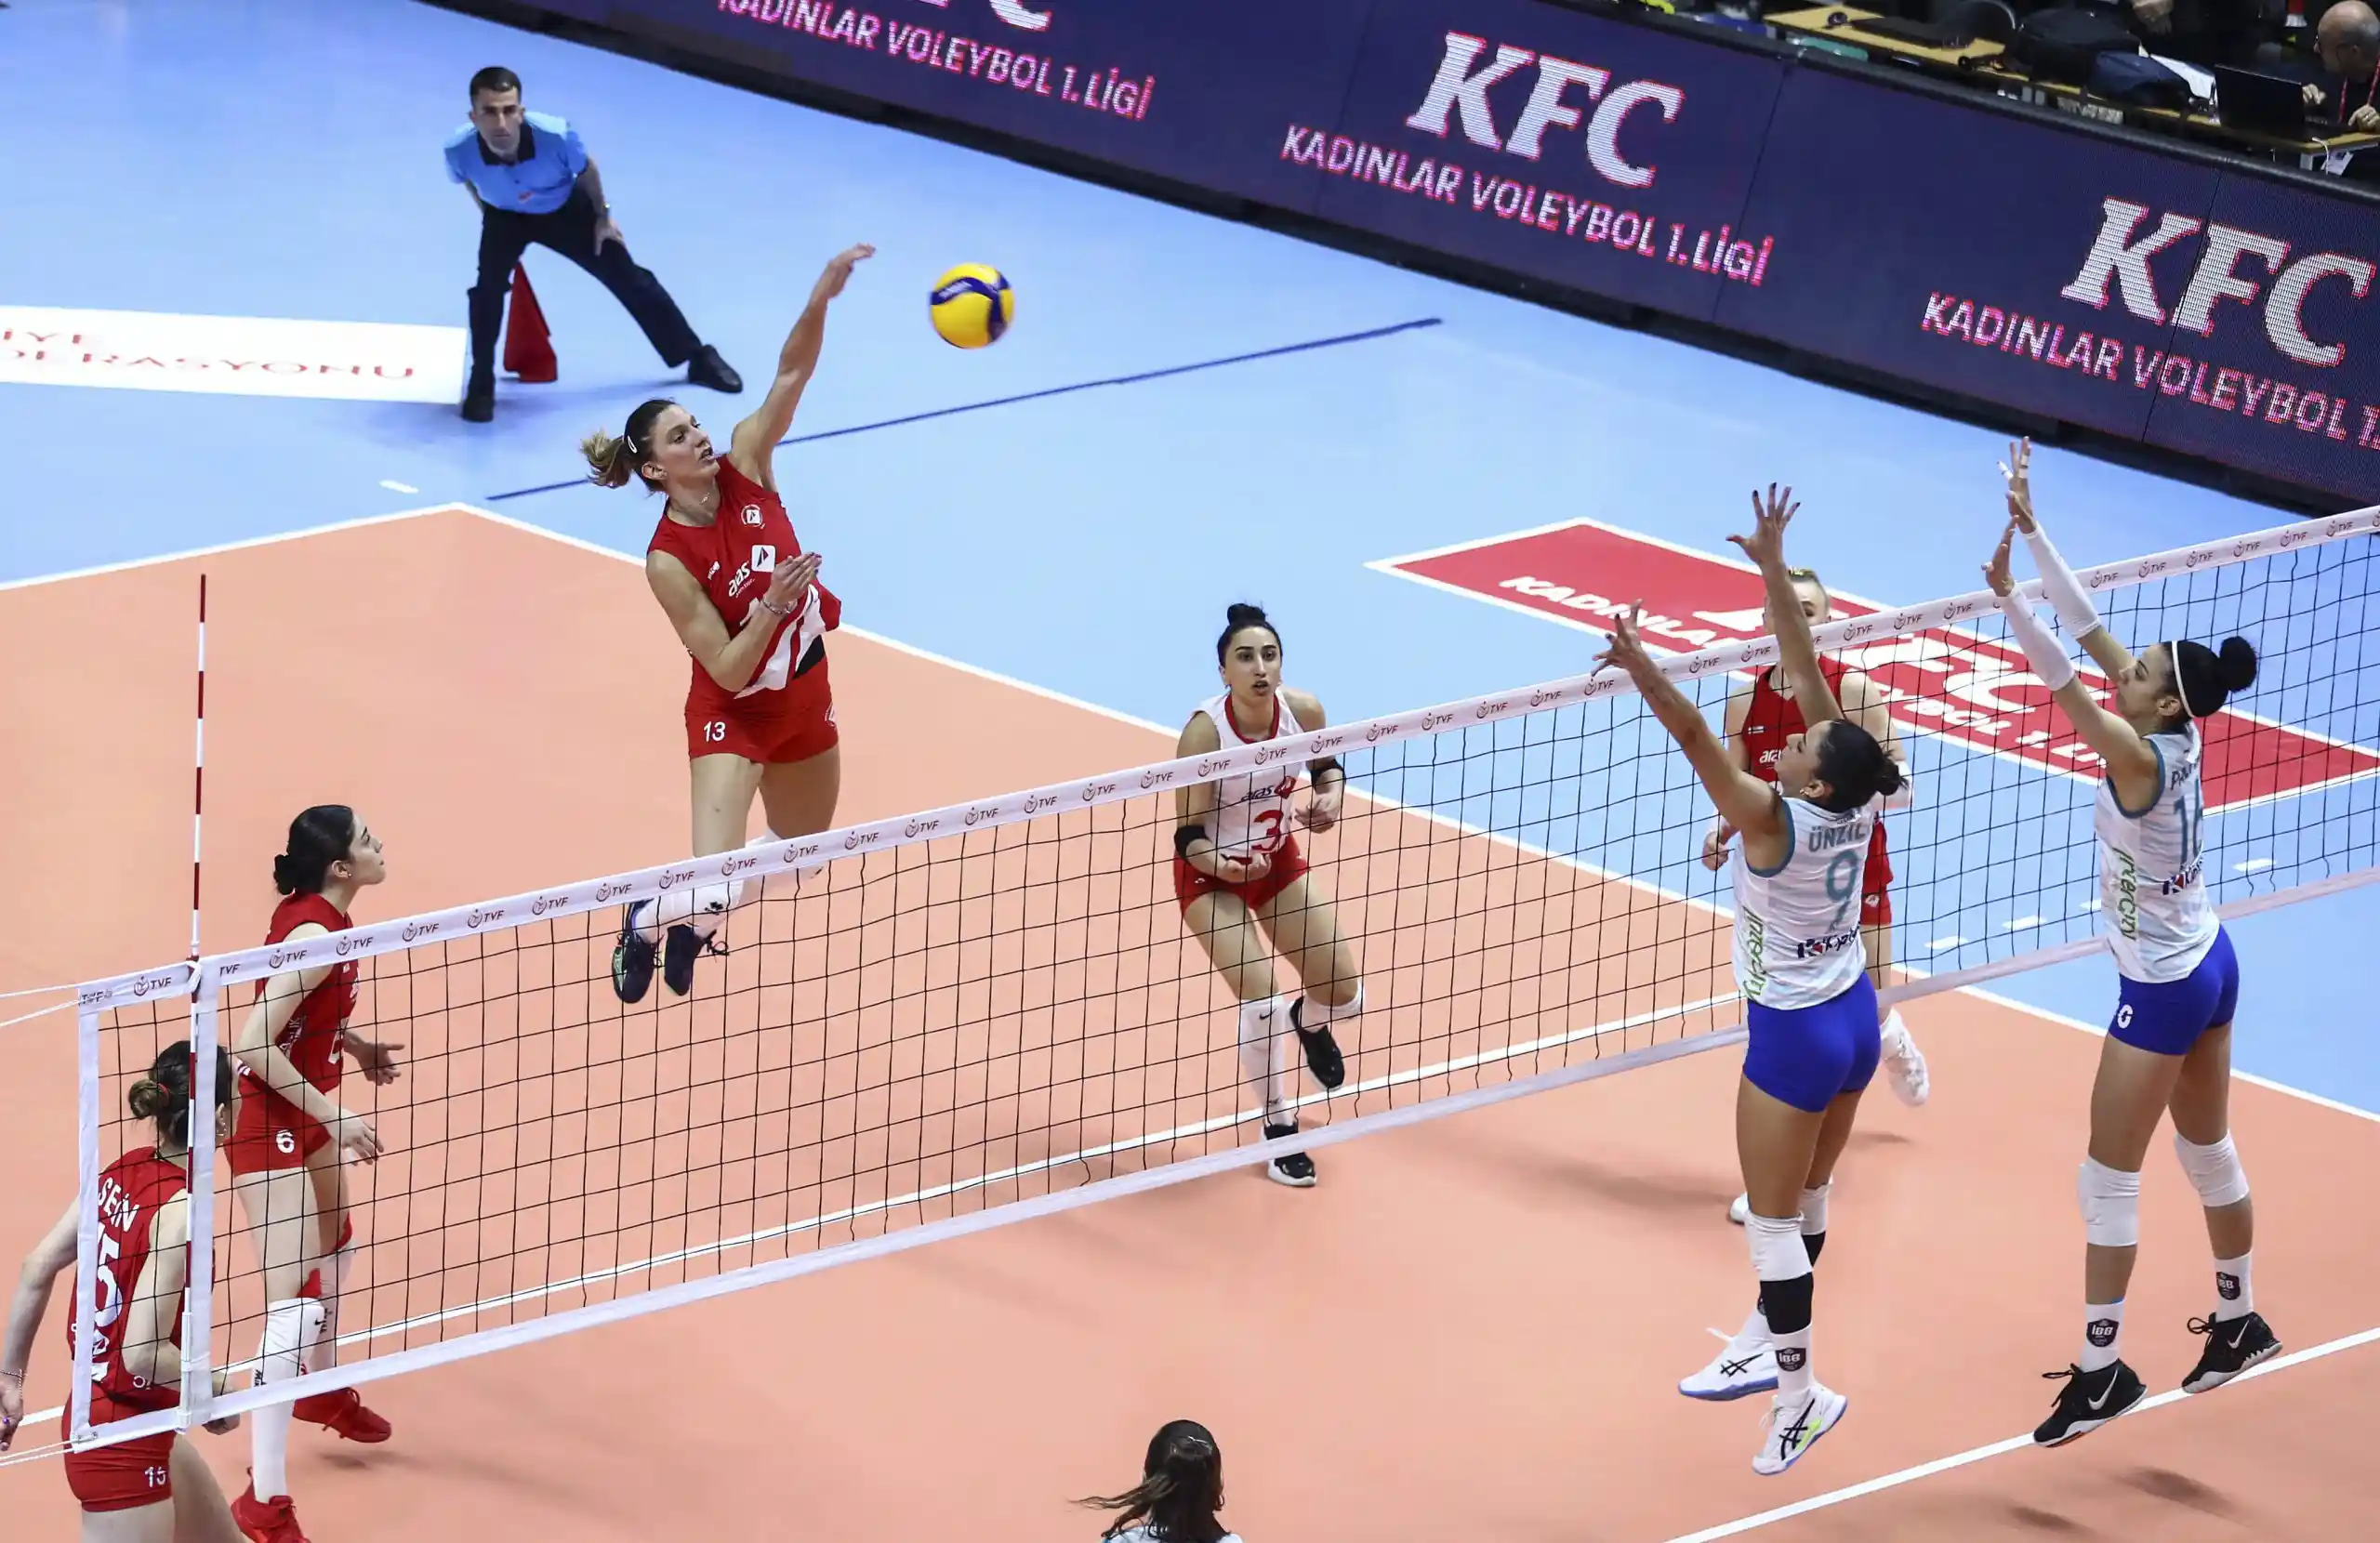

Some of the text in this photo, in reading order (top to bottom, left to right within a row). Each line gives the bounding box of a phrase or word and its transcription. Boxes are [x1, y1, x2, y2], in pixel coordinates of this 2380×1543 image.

[887, 20, 1053, 97] VOLEYBOL
[1404, 30, 1686, 189] KFC
[1280, 123, 1463, 205] KADINLAR
[1472, 170, 1657, 257] VOLEYBOL
[2060, 195, 2377, 366] KFC
[1921, 291, 2124, 381] KADINLAR
[2134, 345, 2347, 442] VOLEYBOL
[1956, 602, 1974, 615] TVF
[1906, 613, 1924, 626] TVF
[1856, 624, 1874, 637] TVF
[1753, 645, 1771, 658] TVF
[1702, 656, 1721, 669] TVF
[1597, 679, 1615, 692] TVF
[1543, 691, 1563, 703] TVF
[1489, 702, 1509, 715] TVF
[1435, 713, 1454, 726] TVF
[704, 720, 726, 742] 13
[1380, 724, 1399, 737] TVF
[1325, 735, 1343, 748] TVF
[1269, 747, 1288, 760] TVF
[1211, 758, 1232, 772] TVF
[1155, 771, 1174, 784] TVF
[1097, 784, 1117, 797] TVF
[1038, 796, 1058, 809] TVF
[979, 808, 999, 821] TVF
[919, 820, 940, 833] TVF
[1250, 809, 1284, 851] 3
[860, 832, 879, 845] TVF
[799, 844, 819, 858] TVF
[737, 857, 758, 870] TVF
[675, 870, 695, 884] TVF
[612, 883, 632, 897] TVF
[1825, 848, 1858, 934] 9
[548, 896, 569, 910] TVF
[483, 909, 505, 923] TVF
[418, 922, 440, 936] TVF
[352, 936, 374, 950] TVF
[285, 949, 308, 963] TVF
[219, 963, 241, 977] TVF
[150, 976, 172, 990] TVF
[275, 1128, 295, 1154] 6
[95, 1220, 124, 1328] 5
[144, 1465, 167, 1488] 15
